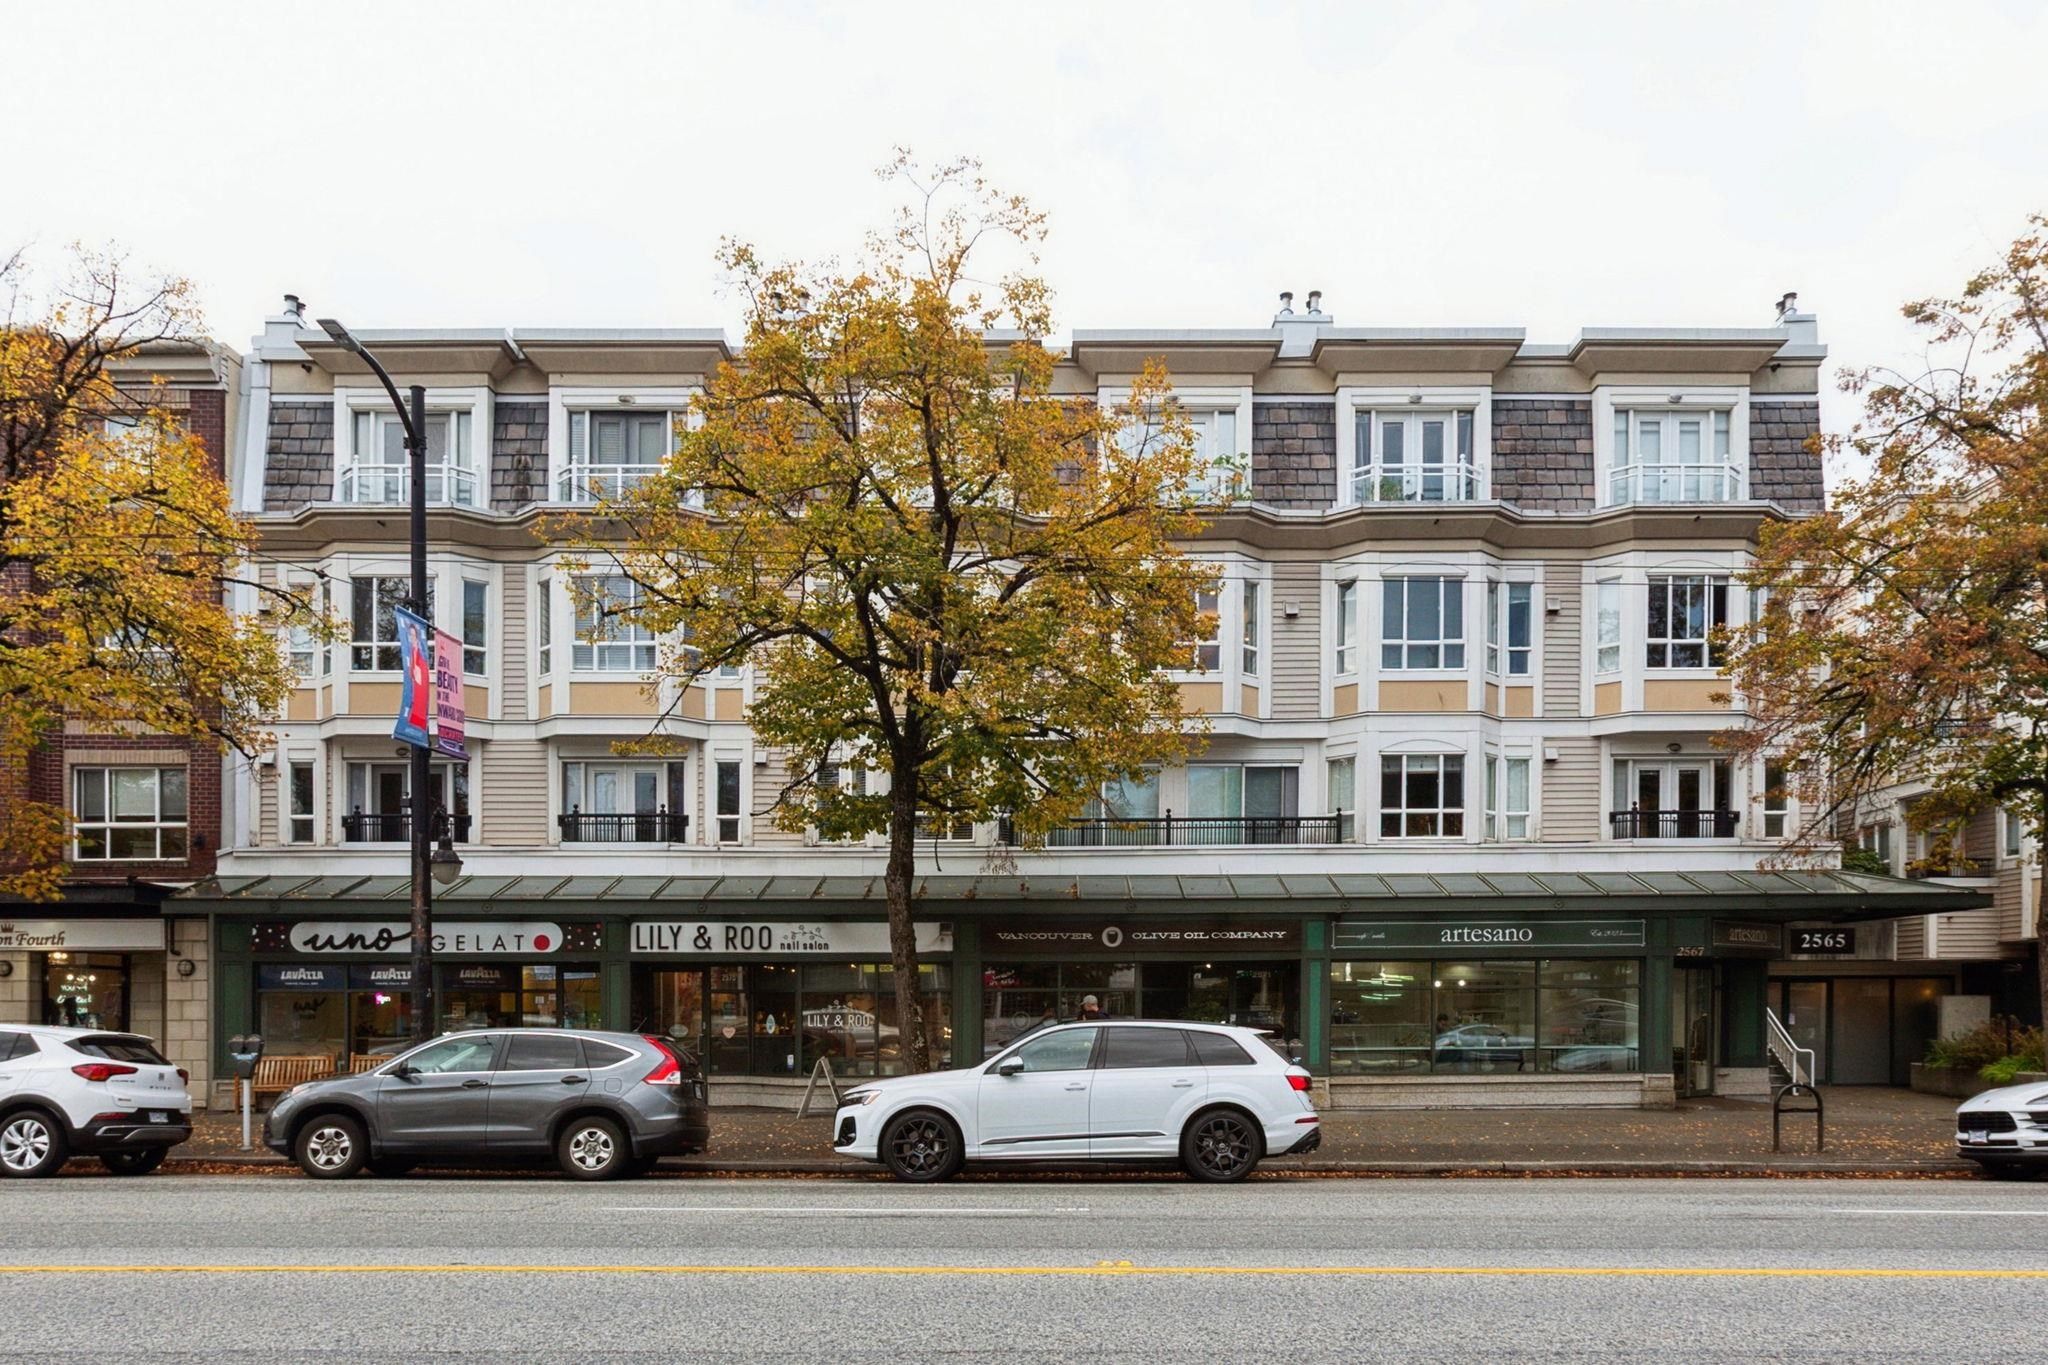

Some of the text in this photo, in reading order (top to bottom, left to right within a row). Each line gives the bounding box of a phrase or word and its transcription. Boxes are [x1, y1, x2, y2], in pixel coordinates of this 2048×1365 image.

[437, 670, 458, 694] BEAUTY
[15, 931, 65, 946] Fourth
[303, 928, 412, 951] uno
[636, 925, 772, 950] LILY & ROO
[997, 932, 1094, 940] VANCOUVER
[1131, 932, 1180, 940] OLIVE
[1211, 931, 1287, 939] COMPANY
[1441, 926, 1533, 943] artesano
[1728, 927, 1768, 942] artesano
[1801, 934, 1846, 948] 2565
[780, 941, 829, 951] nail salon
[1676, 946, 1705, 957] 2567
[280, 968, 324, 980] LAVAZZA
[459, 966, 501, 979] LAVAZZA
[807, 1014, 869, 1027] LILY & ROO
